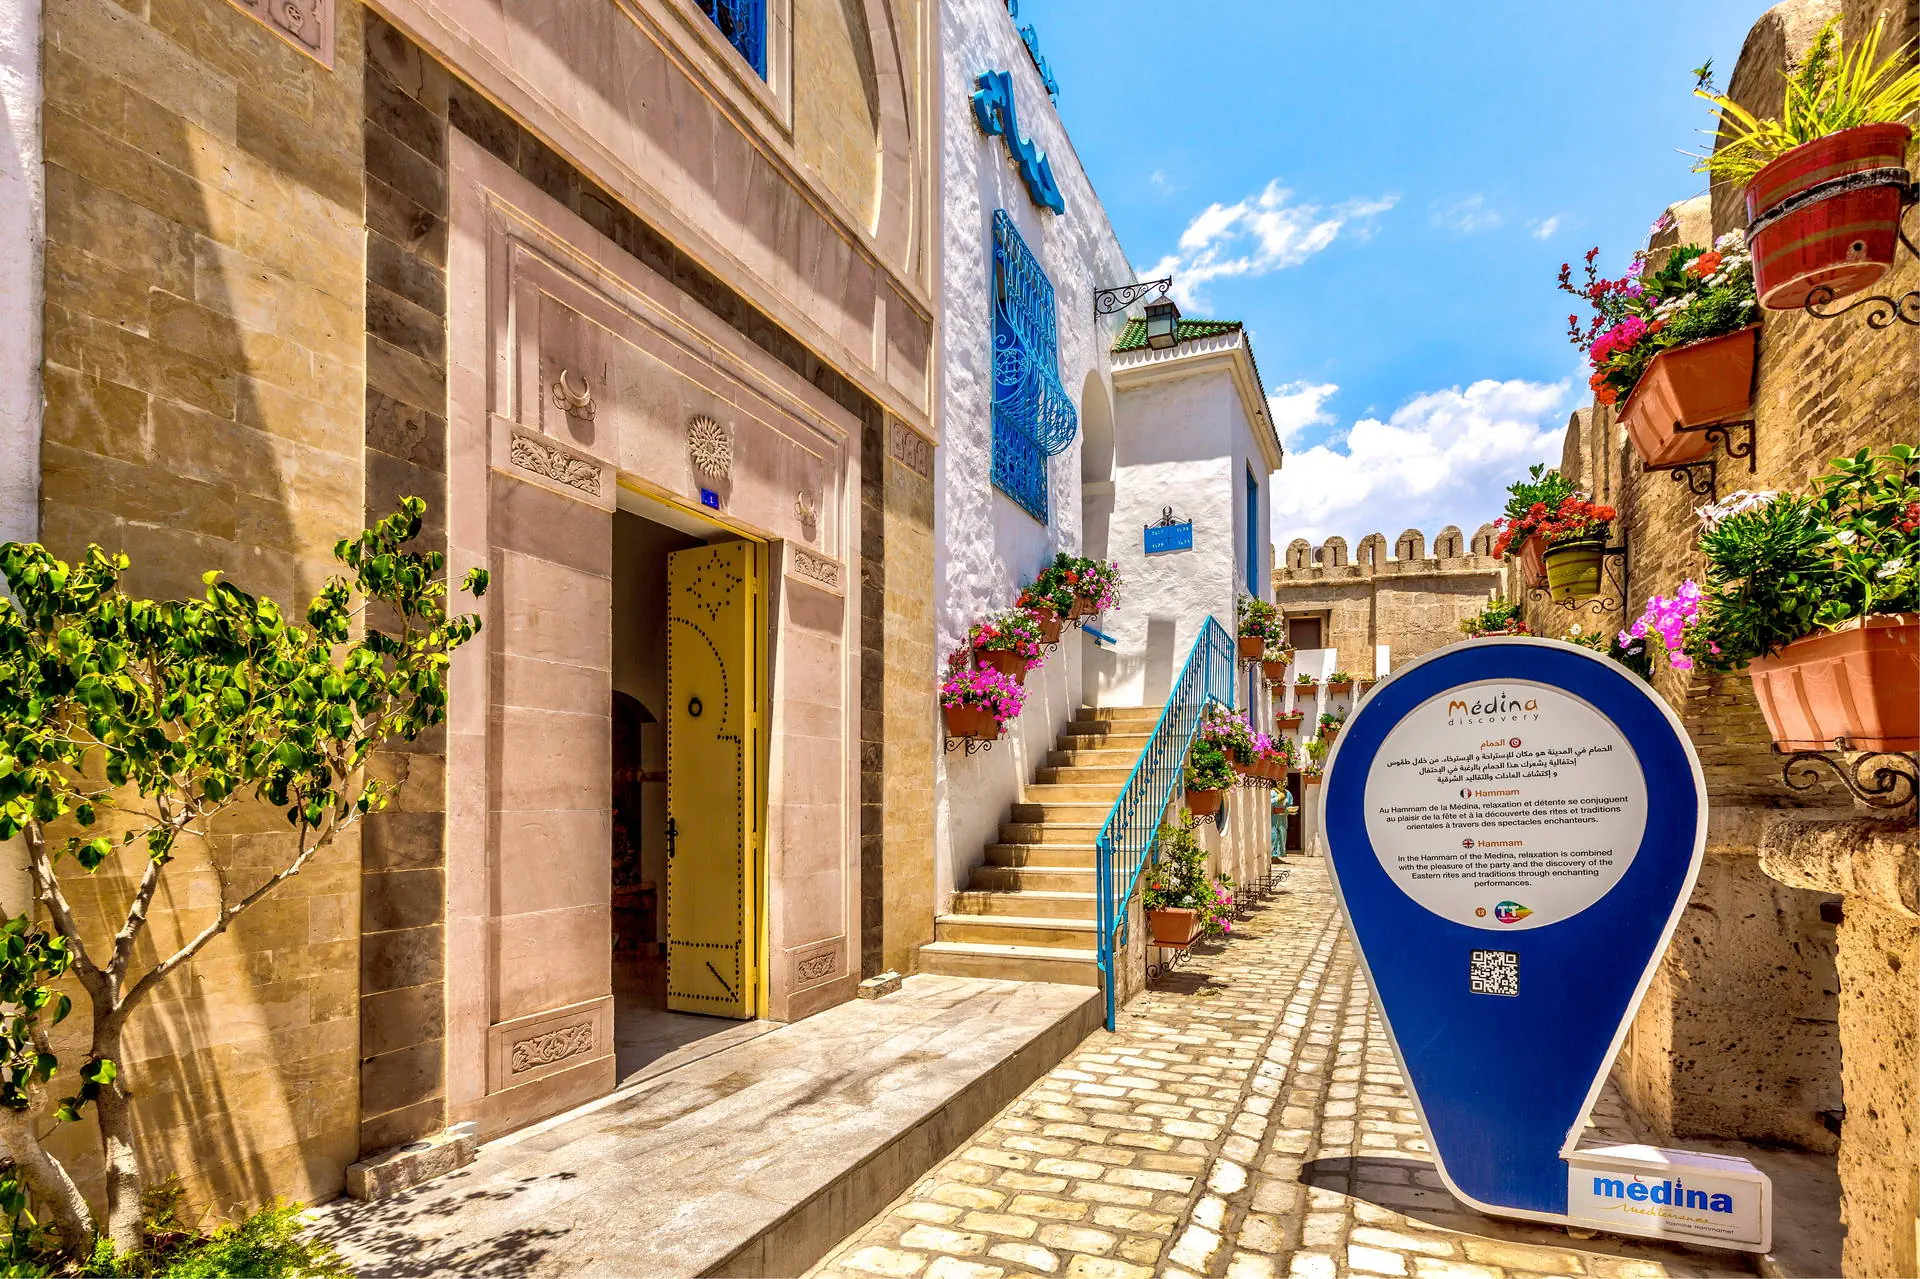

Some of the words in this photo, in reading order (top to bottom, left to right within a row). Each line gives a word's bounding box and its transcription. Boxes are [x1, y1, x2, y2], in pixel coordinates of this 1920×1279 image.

[1449, 691, 1538, 716] Médina
[1448, 714, 1538, 726] discovery
[1480, 739, 1505, 750] الحمام
[1475, 789, 1519, 797] Hammam
[1429, 804, 1438, 812] de
[1450, 803, 1480, 811] Médina,
[1483, 800, 1521, 809] relaxation
[1580, 796, 1628, 805] conjuguent
[1398, 815, 1420, 823] plaisir
[1469, 811, 1473, 819] à
[1485, 809, 1530, 818] découverte
[1532, 808, 1547, 816] des
[1581, 806, 1621, 814] traditions
[1482, 820, 1496, 828] des
[1498, 819, 1541, 828] spectacles
[1544, 816, 1598, 825] enchanteurs.
[1478, 840, 1522, 848] Hammam
[1485, 851, 1516, 860] Medina,
[1570, 849, 1612, 857] combined
[1431, 863, 1463, 872] pleasure
[1490, 862, 1510, 870] party
[1479, 870, 1516, 878] traditions
[1518, 870, 1549, 878] through
[1552, 869, 1598, 877] enchanting
[1474, 880, 1531, 888] performances.
[1498, 905, 1520, 917] TT
